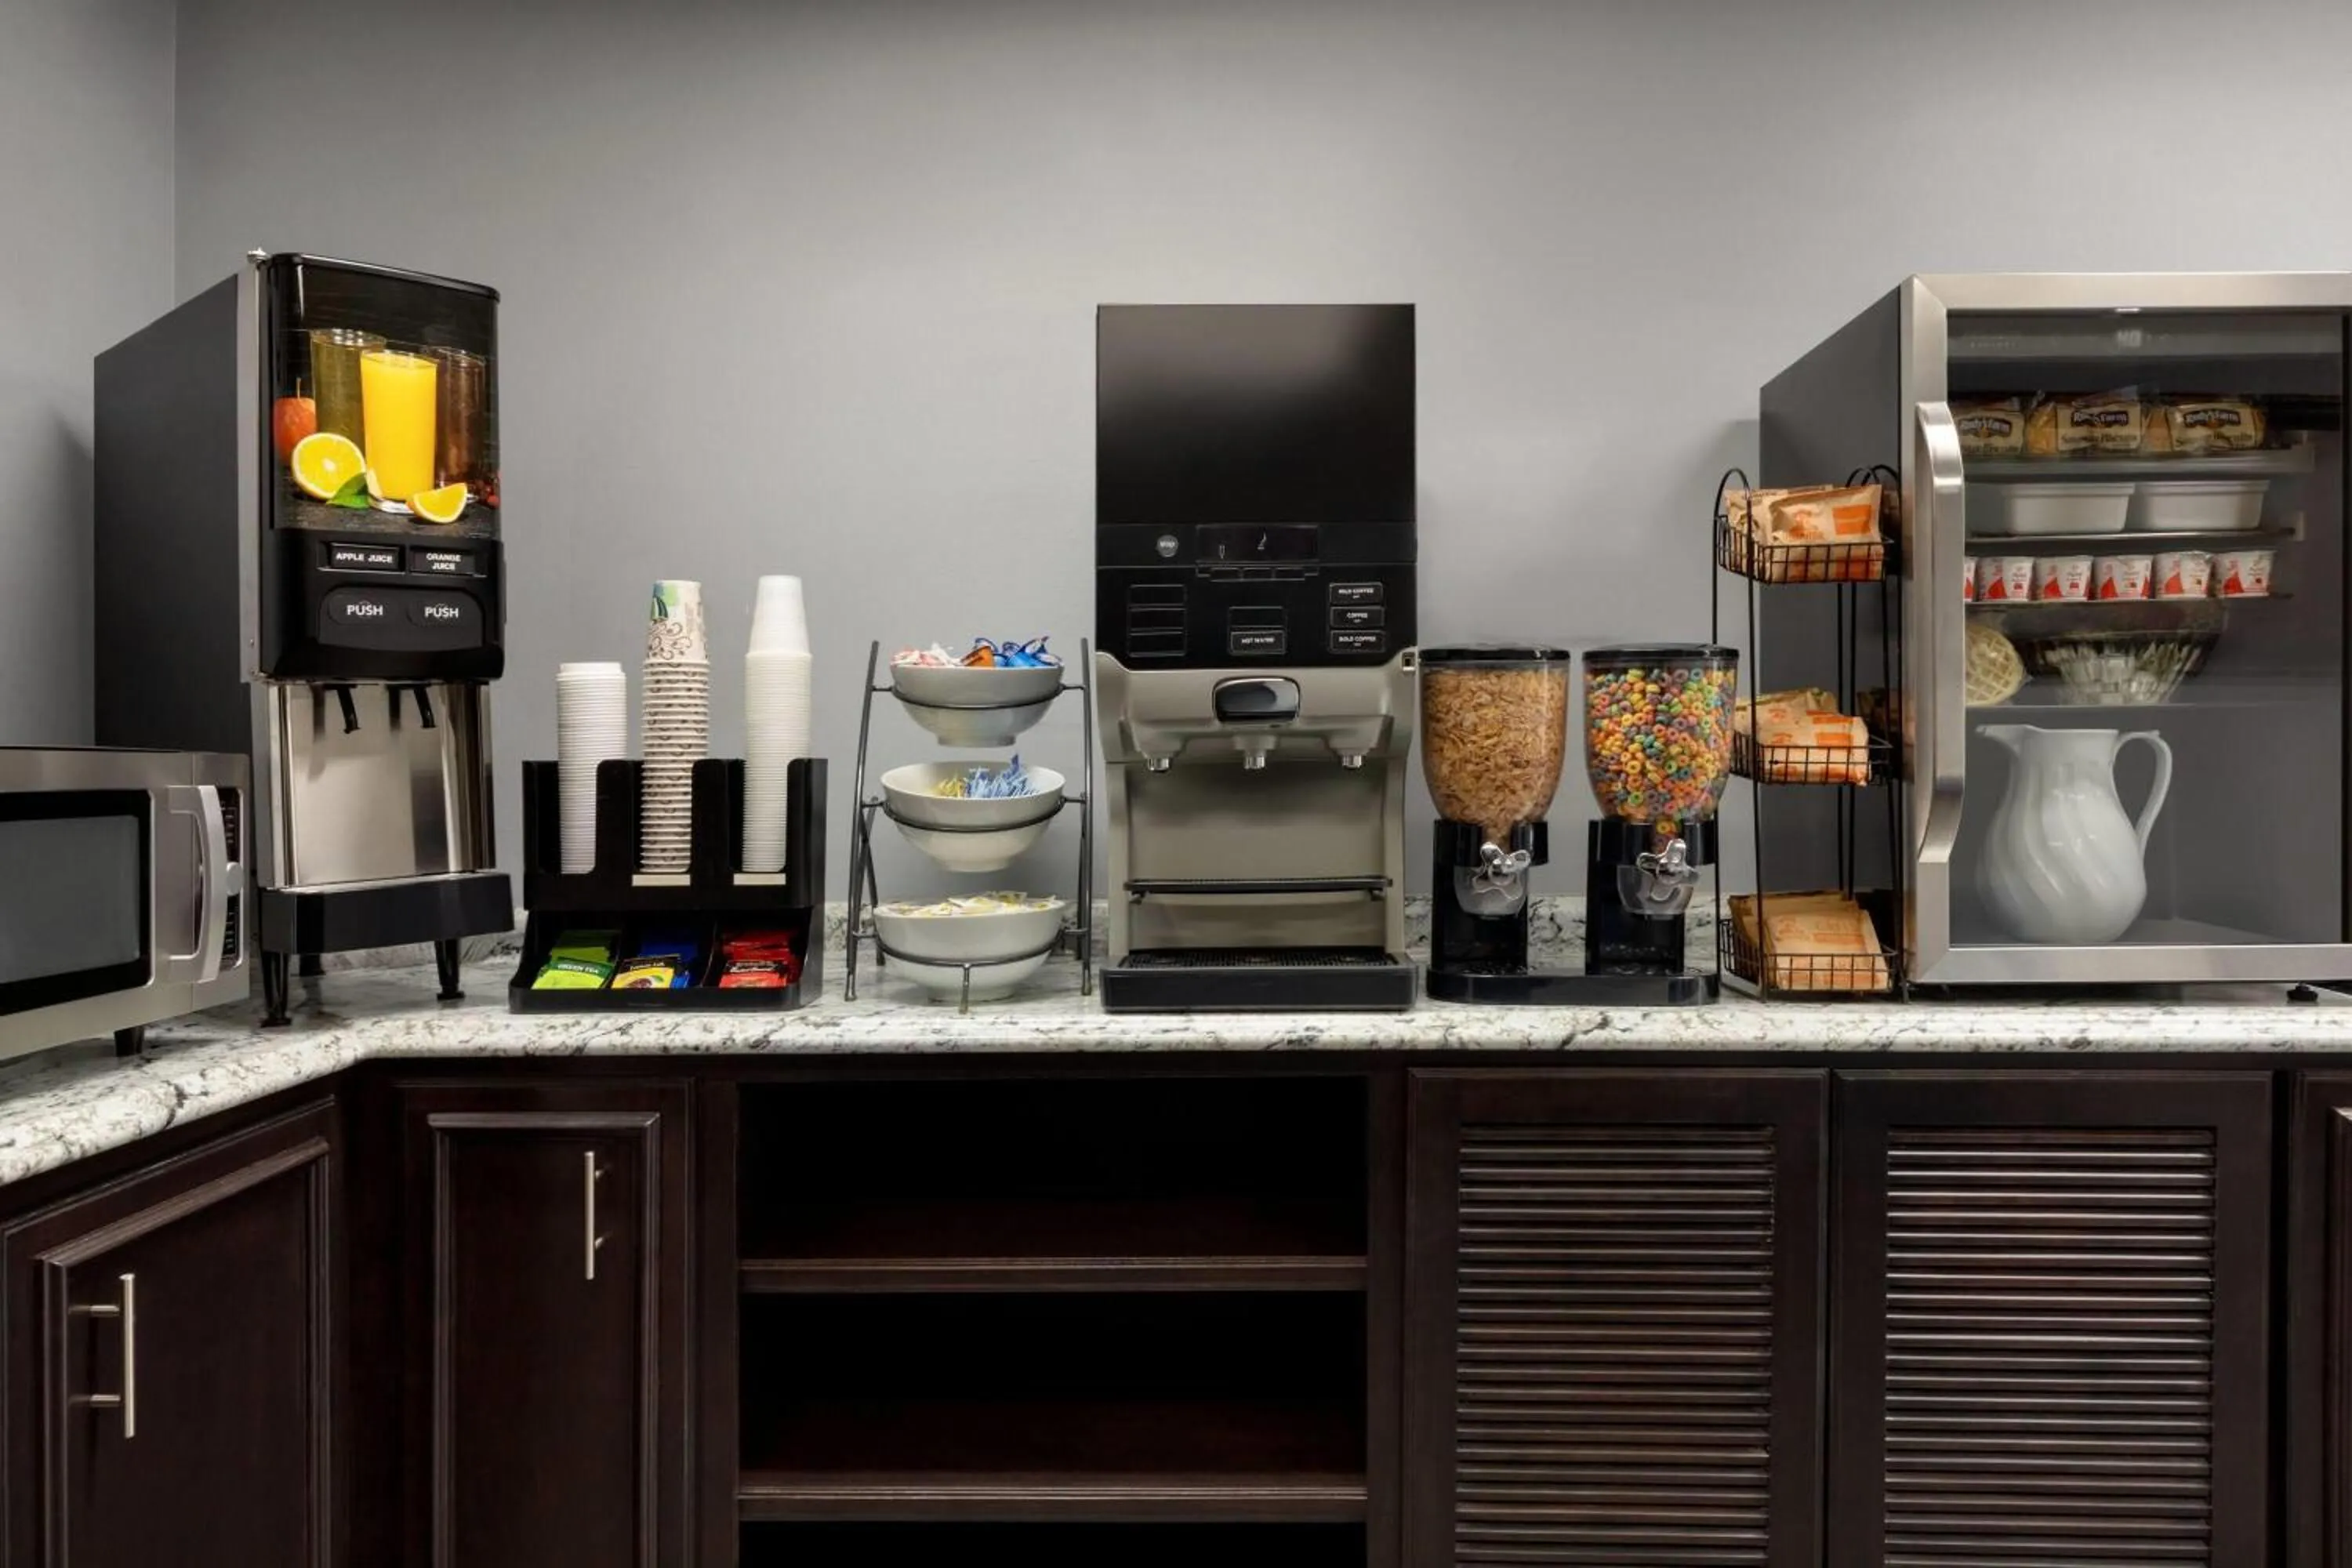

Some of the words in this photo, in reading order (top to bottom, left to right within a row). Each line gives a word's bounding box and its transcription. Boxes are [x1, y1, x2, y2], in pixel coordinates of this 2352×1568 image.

[336, 552, 365, 561] APPLE
[368, 554, 393, 564] JUICE
[426, 552, 461, 561] ORANGE
[432, 561, 456, 571] JUICE
[346, 604, 383, 616] PUSH
[424, 606, 459, 618] PUSH
[557, 963, 584, 972] GREEN
